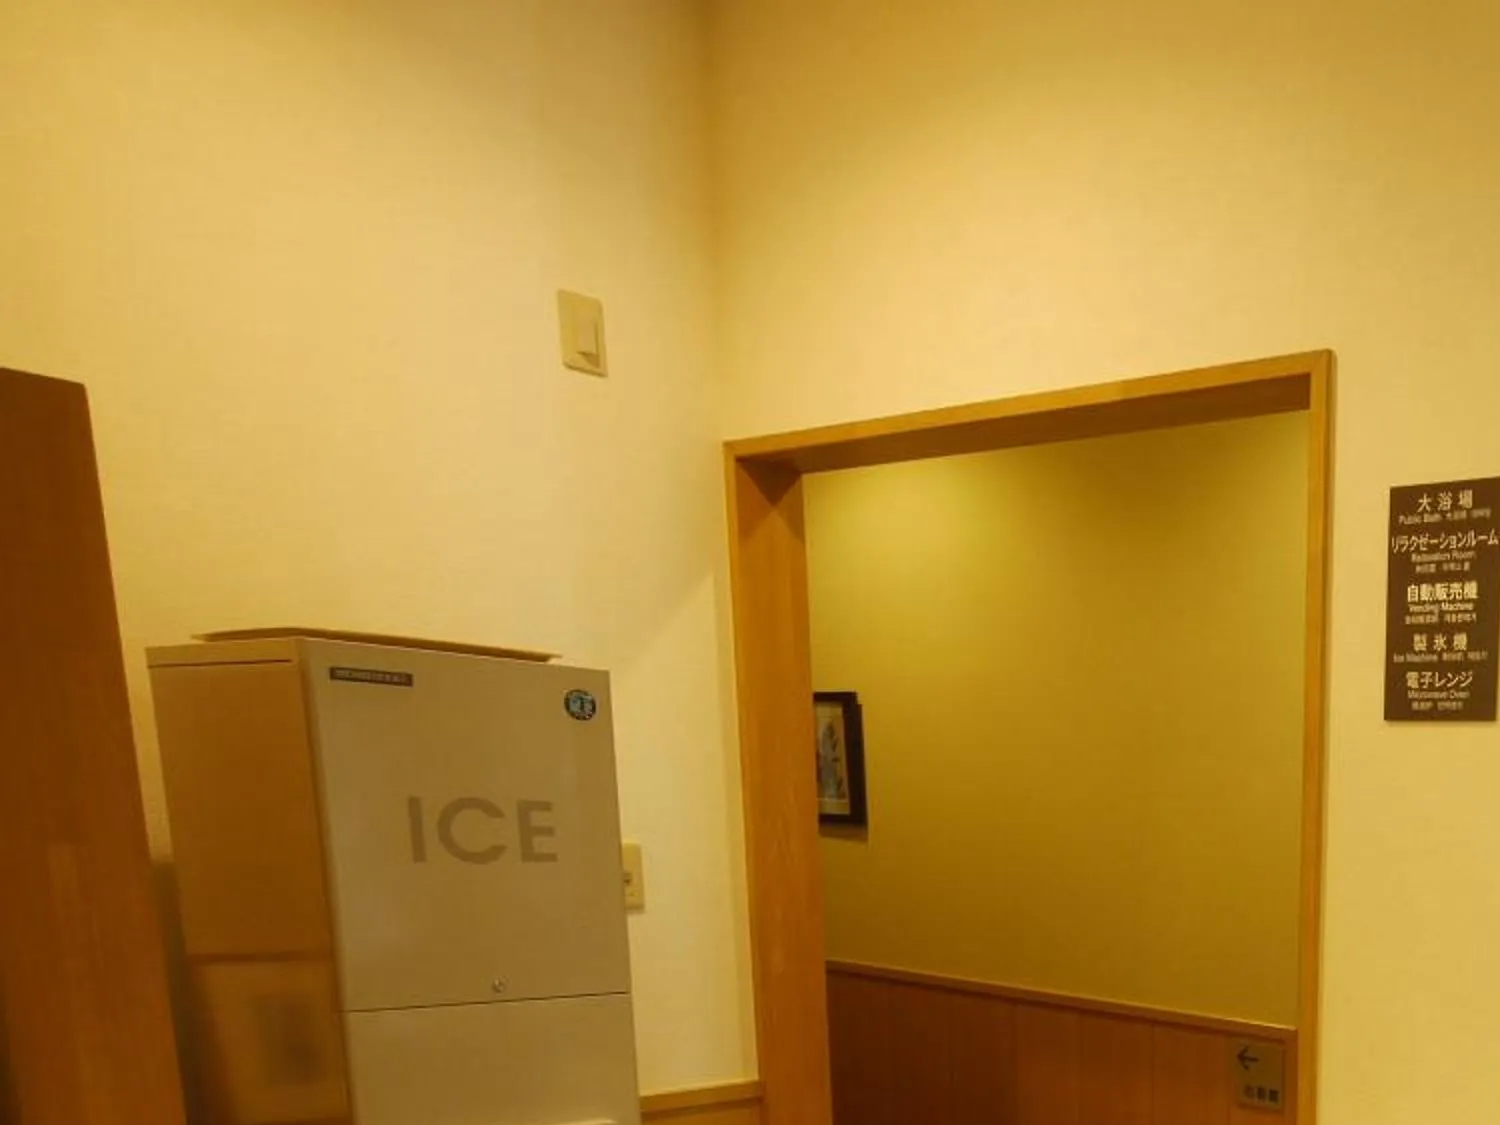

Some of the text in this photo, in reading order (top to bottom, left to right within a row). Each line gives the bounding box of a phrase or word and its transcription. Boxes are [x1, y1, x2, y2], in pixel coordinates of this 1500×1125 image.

[1416, 489, 1473, 513] 大浴場
[1390, 528, 1499, 553] リラクゼーションルーム
[1407, 580, 1479, 603] 自動販売機
[1412, 632, 1468, 652] 製氷機
[1405, 670, 1473, 689] 電子レンジ
[408, 795, 559, 865] ICE
